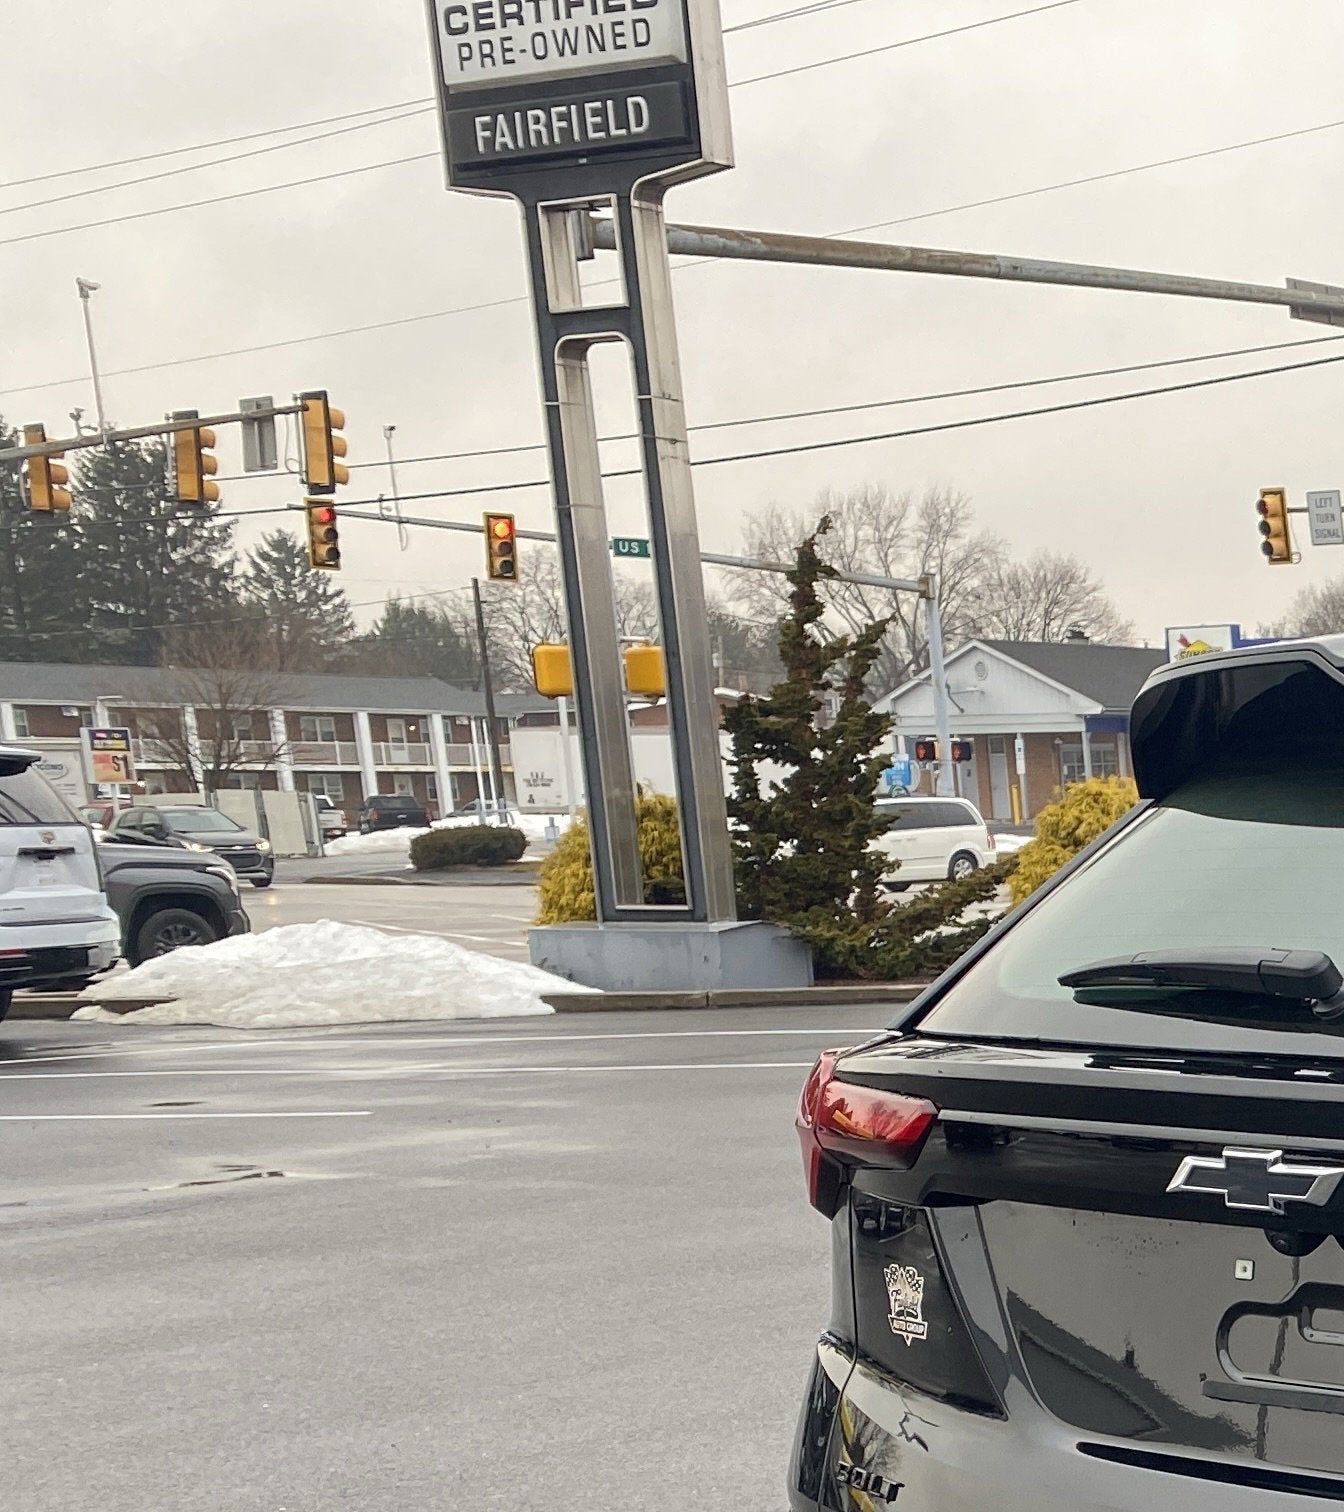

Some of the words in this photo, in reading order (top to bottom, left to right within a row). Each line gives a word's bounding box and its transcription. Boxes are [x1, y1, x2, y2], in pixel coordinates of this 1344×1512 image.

[457, 18, 651, 71] PRE-OWNED
[474, 95, 650, 154] FAIRFIELD
[619, 540, 640, 554] US
